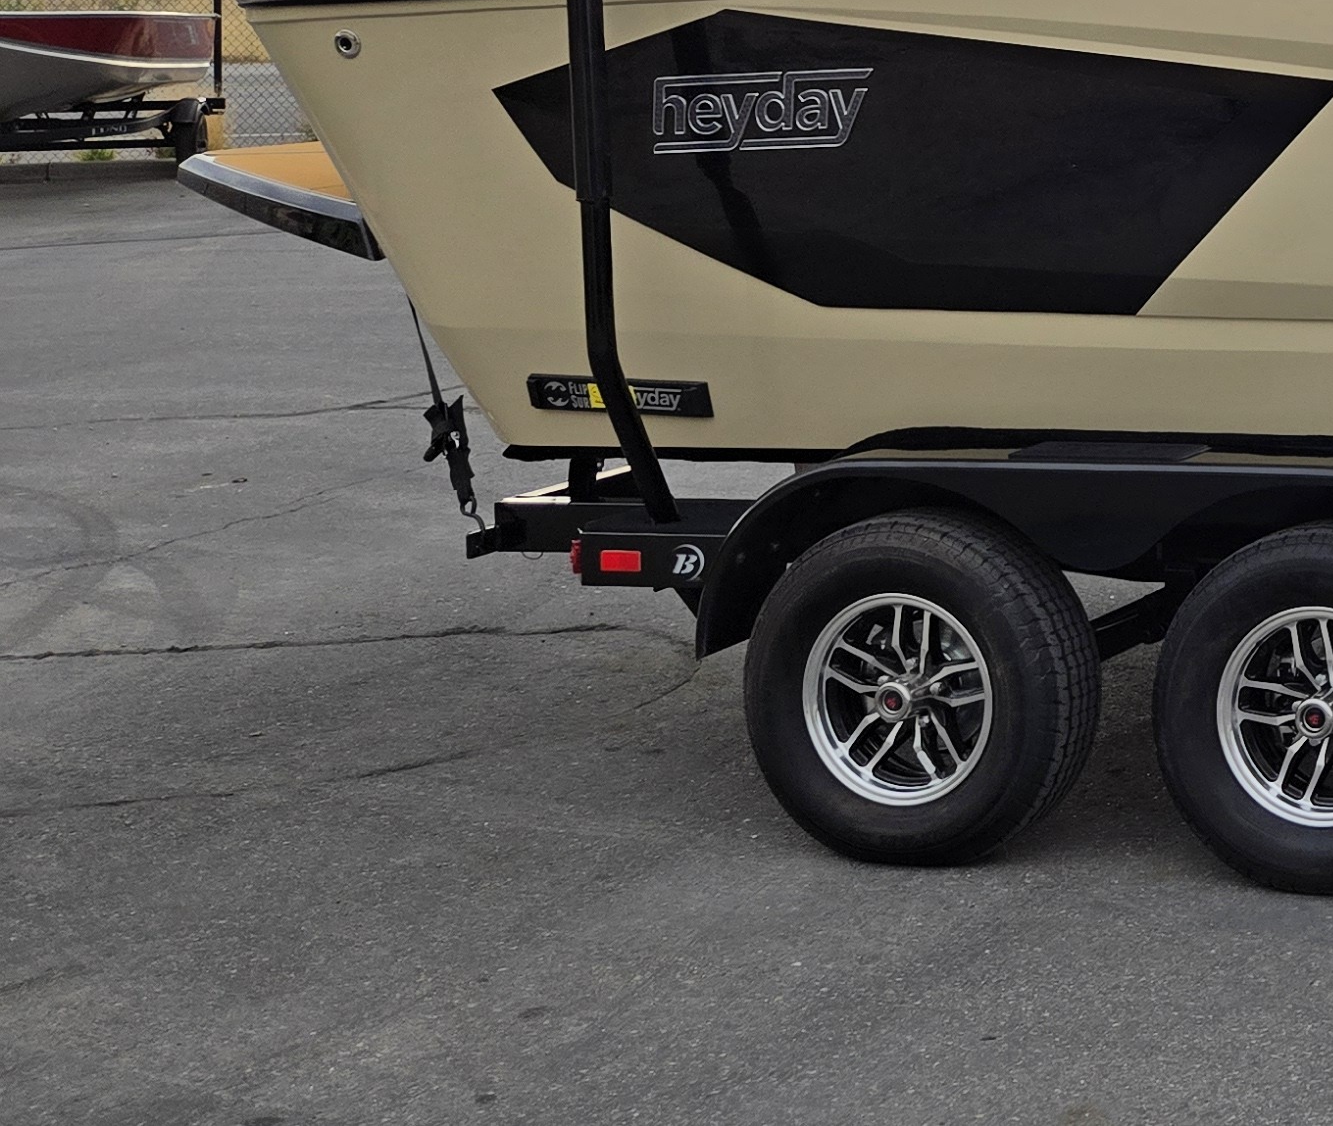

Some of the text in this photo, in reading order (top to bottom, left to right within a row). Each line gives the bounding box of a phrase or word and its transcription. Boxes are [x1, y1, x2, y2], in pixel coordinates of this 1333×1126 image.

[653, 68, 874, 155] heyday
[571, 395, 591, 409] SUR
[633, 386, 683, 412] yday
